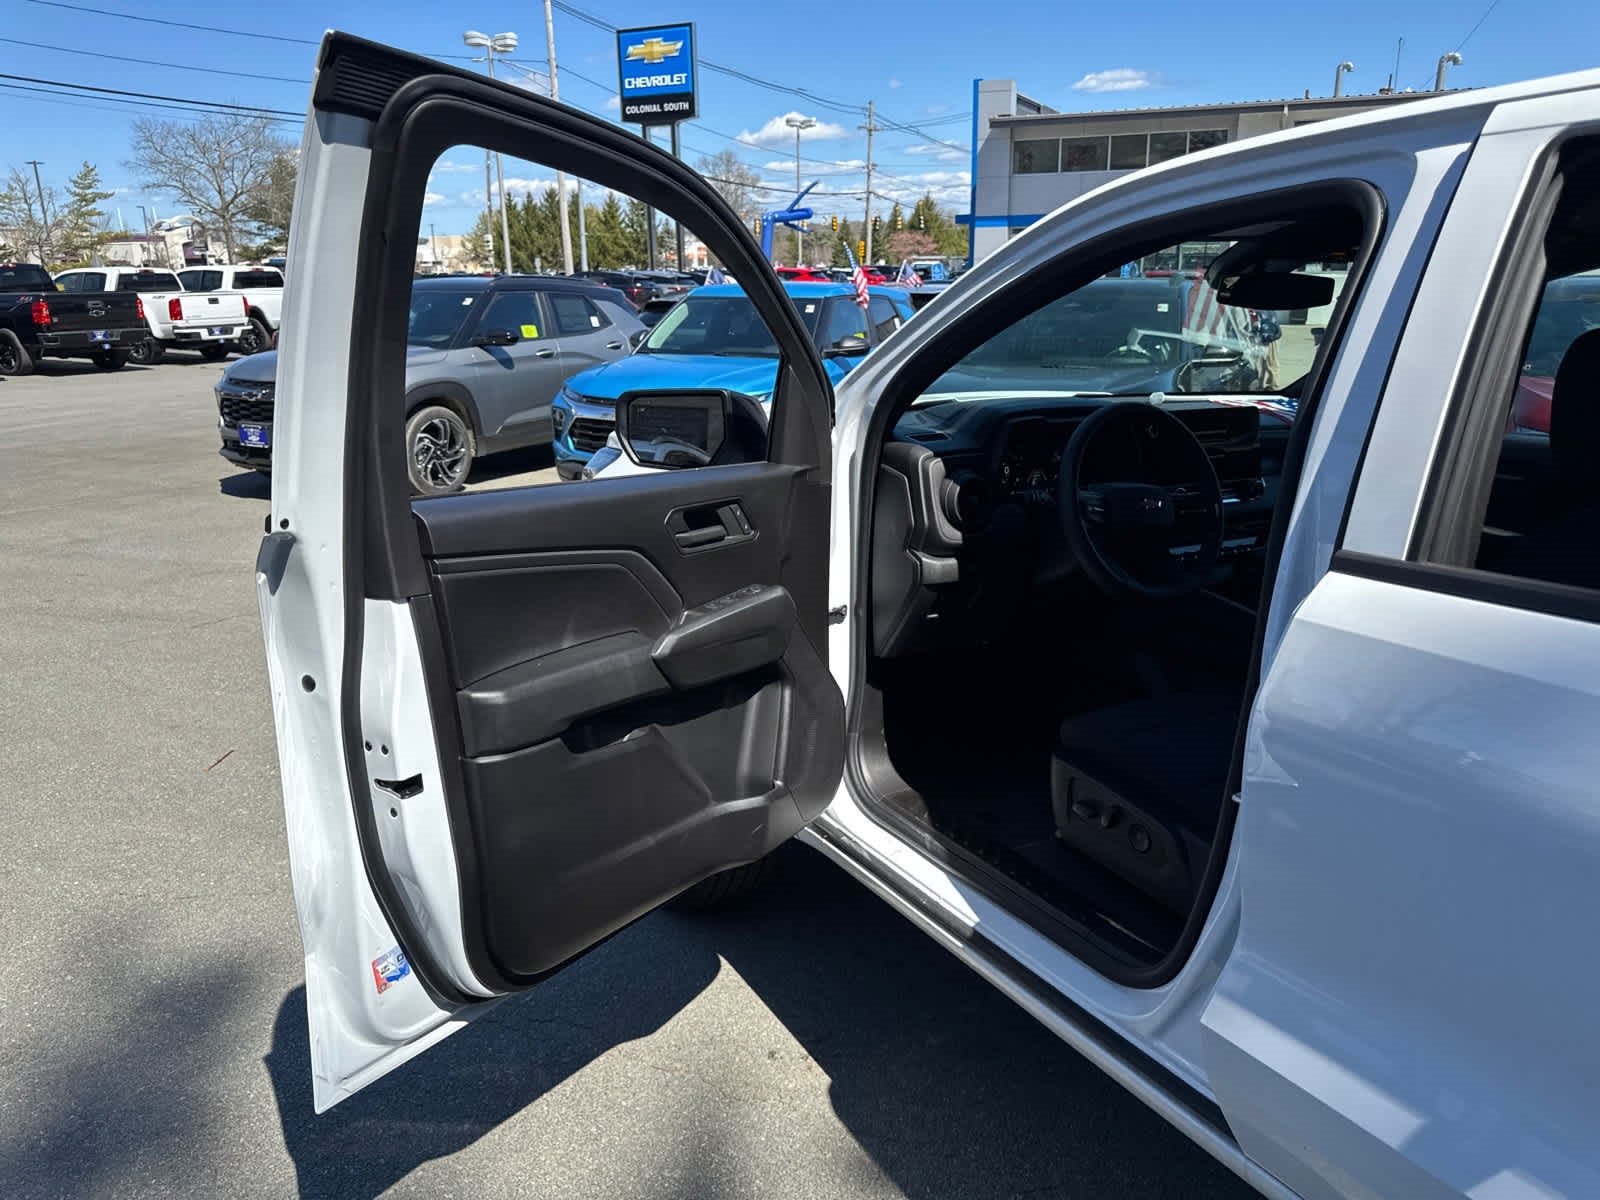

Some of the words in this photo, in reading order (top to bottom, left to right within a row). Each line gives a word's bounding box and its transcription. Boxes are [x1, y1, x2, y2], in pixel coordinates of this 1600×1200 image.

[624, 73, 688, 89] CHEVROLET
[625, 104, 662, 115] COLONIAL
[663, 102, 689, 112] SOUTH
